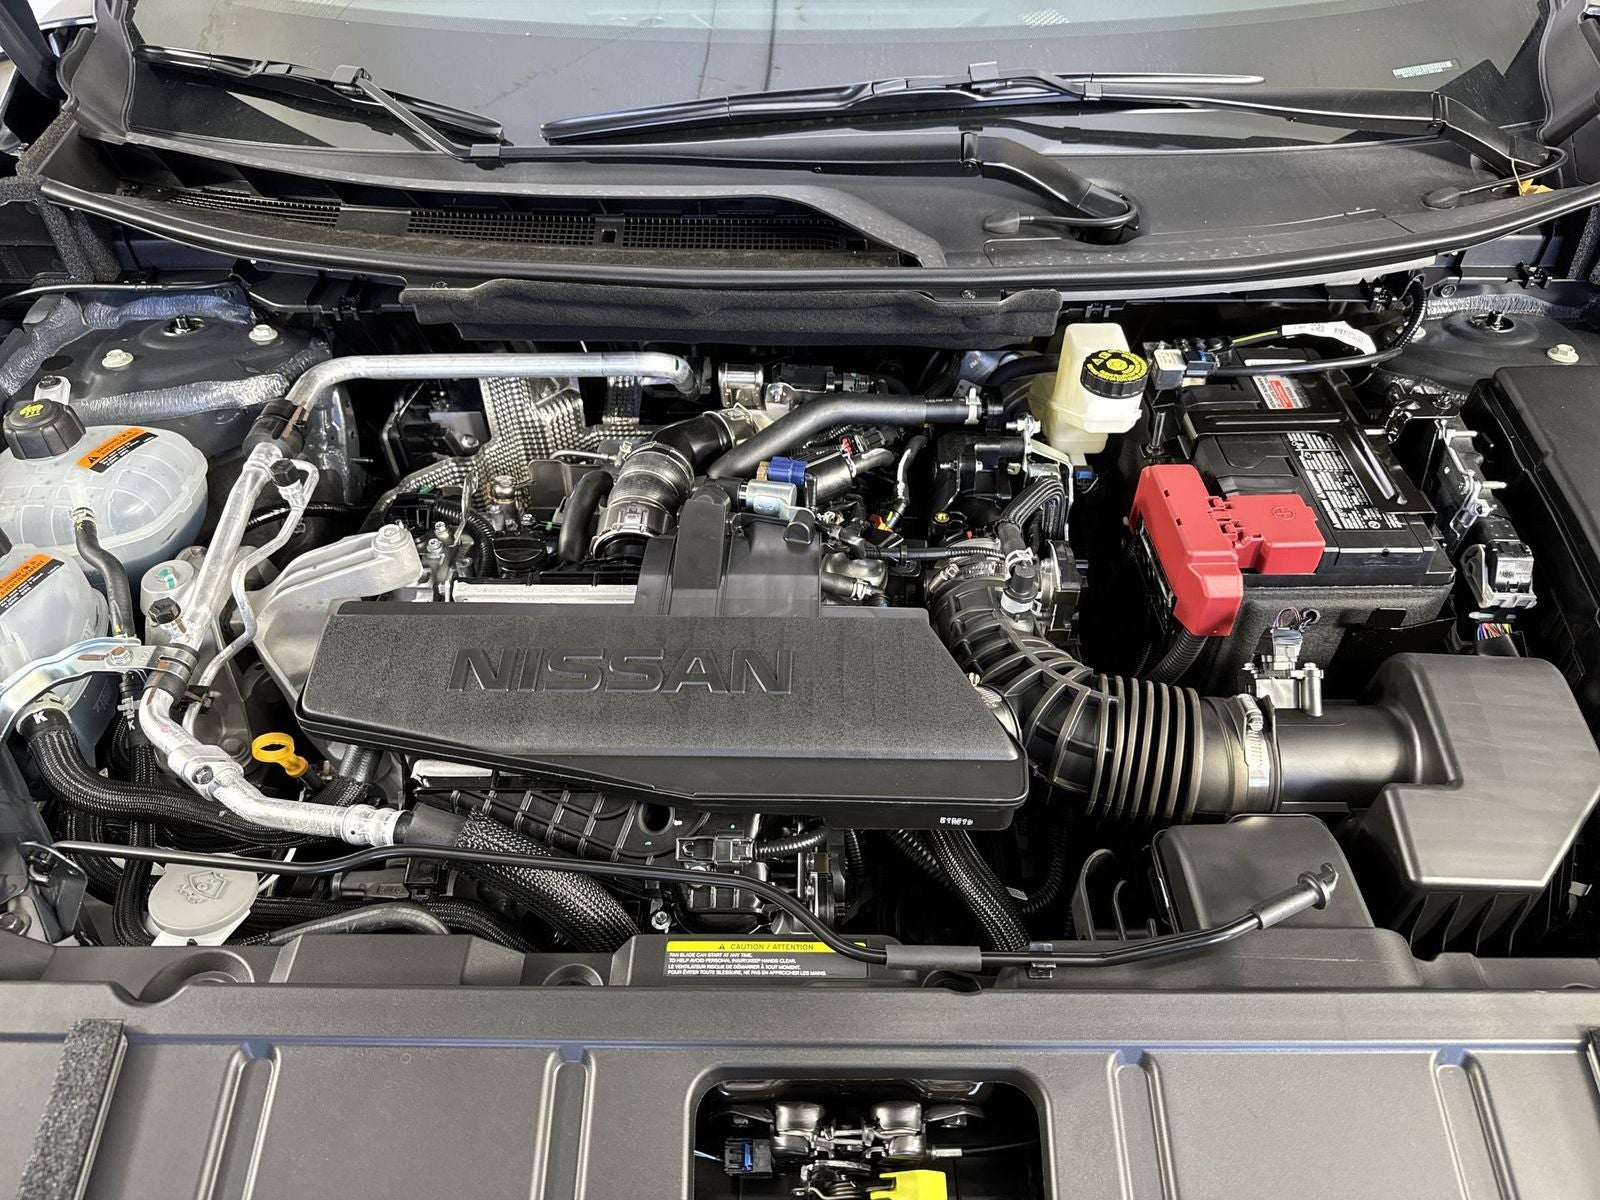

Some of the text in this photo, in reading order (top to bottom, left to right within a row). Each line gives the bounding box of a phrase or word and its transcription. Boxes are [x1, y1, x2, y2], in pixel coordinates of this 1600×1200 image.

[446, 649, 793, 694] NISSAN
[33, 710, 48, 725] K
[128, 719, 136, 731] K
